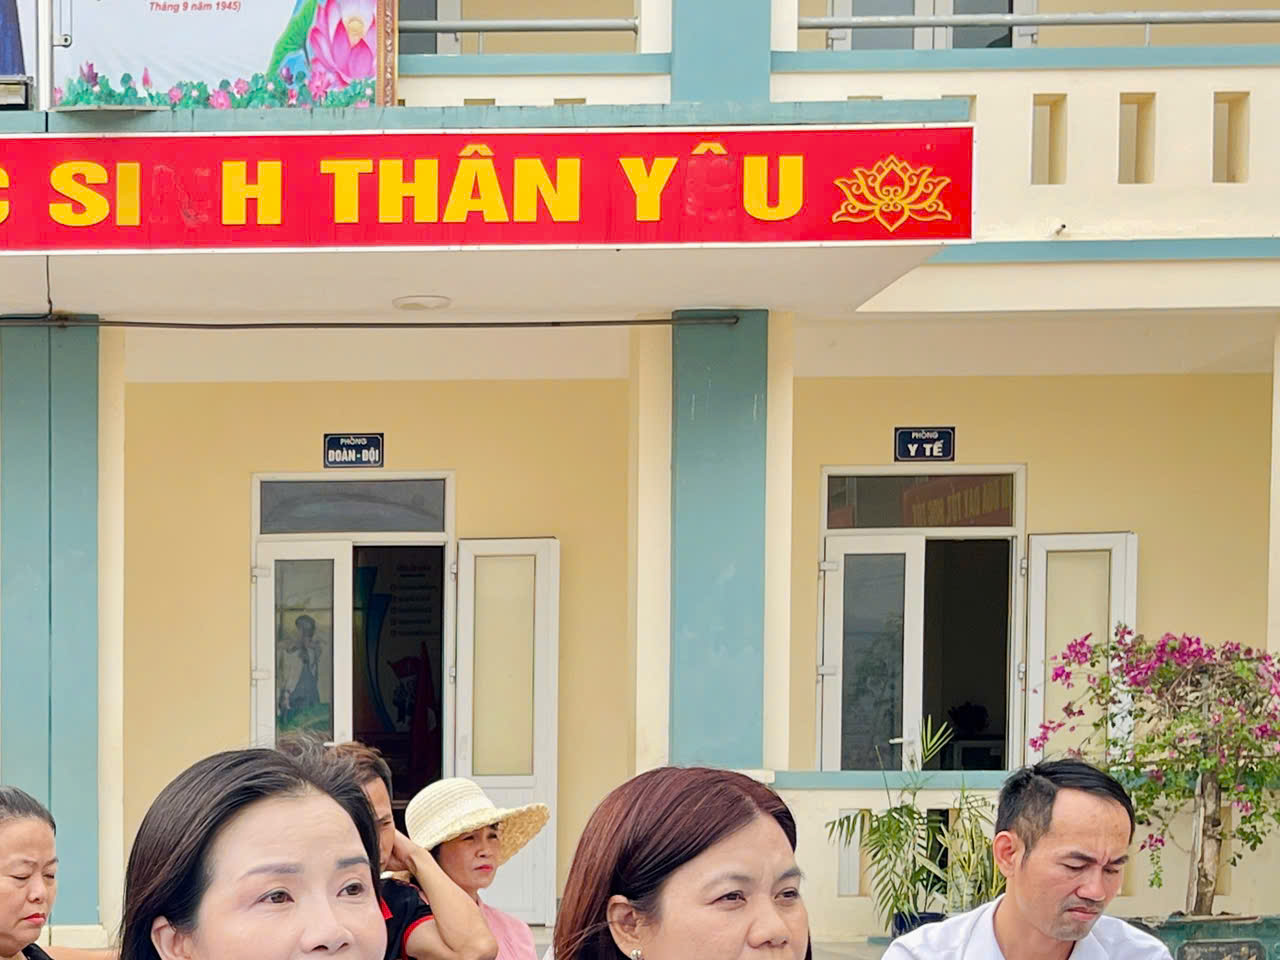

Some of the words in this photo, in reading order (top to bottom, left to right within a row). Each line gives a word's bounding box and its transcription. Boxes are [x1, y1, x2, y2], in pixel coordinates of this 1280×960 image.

[149, 1, 180, 13] Tháng
[182, 1, 189, 11] 9
[191, 2, 213, 11] năm
[216, 1, 241, 12] 1945)
[48, 160, 282, 227] SIH
[319, 143, 582, 224] THÂN
[907, 443, 919, 456] Y
[923, 439, 944, 456] TẾ
